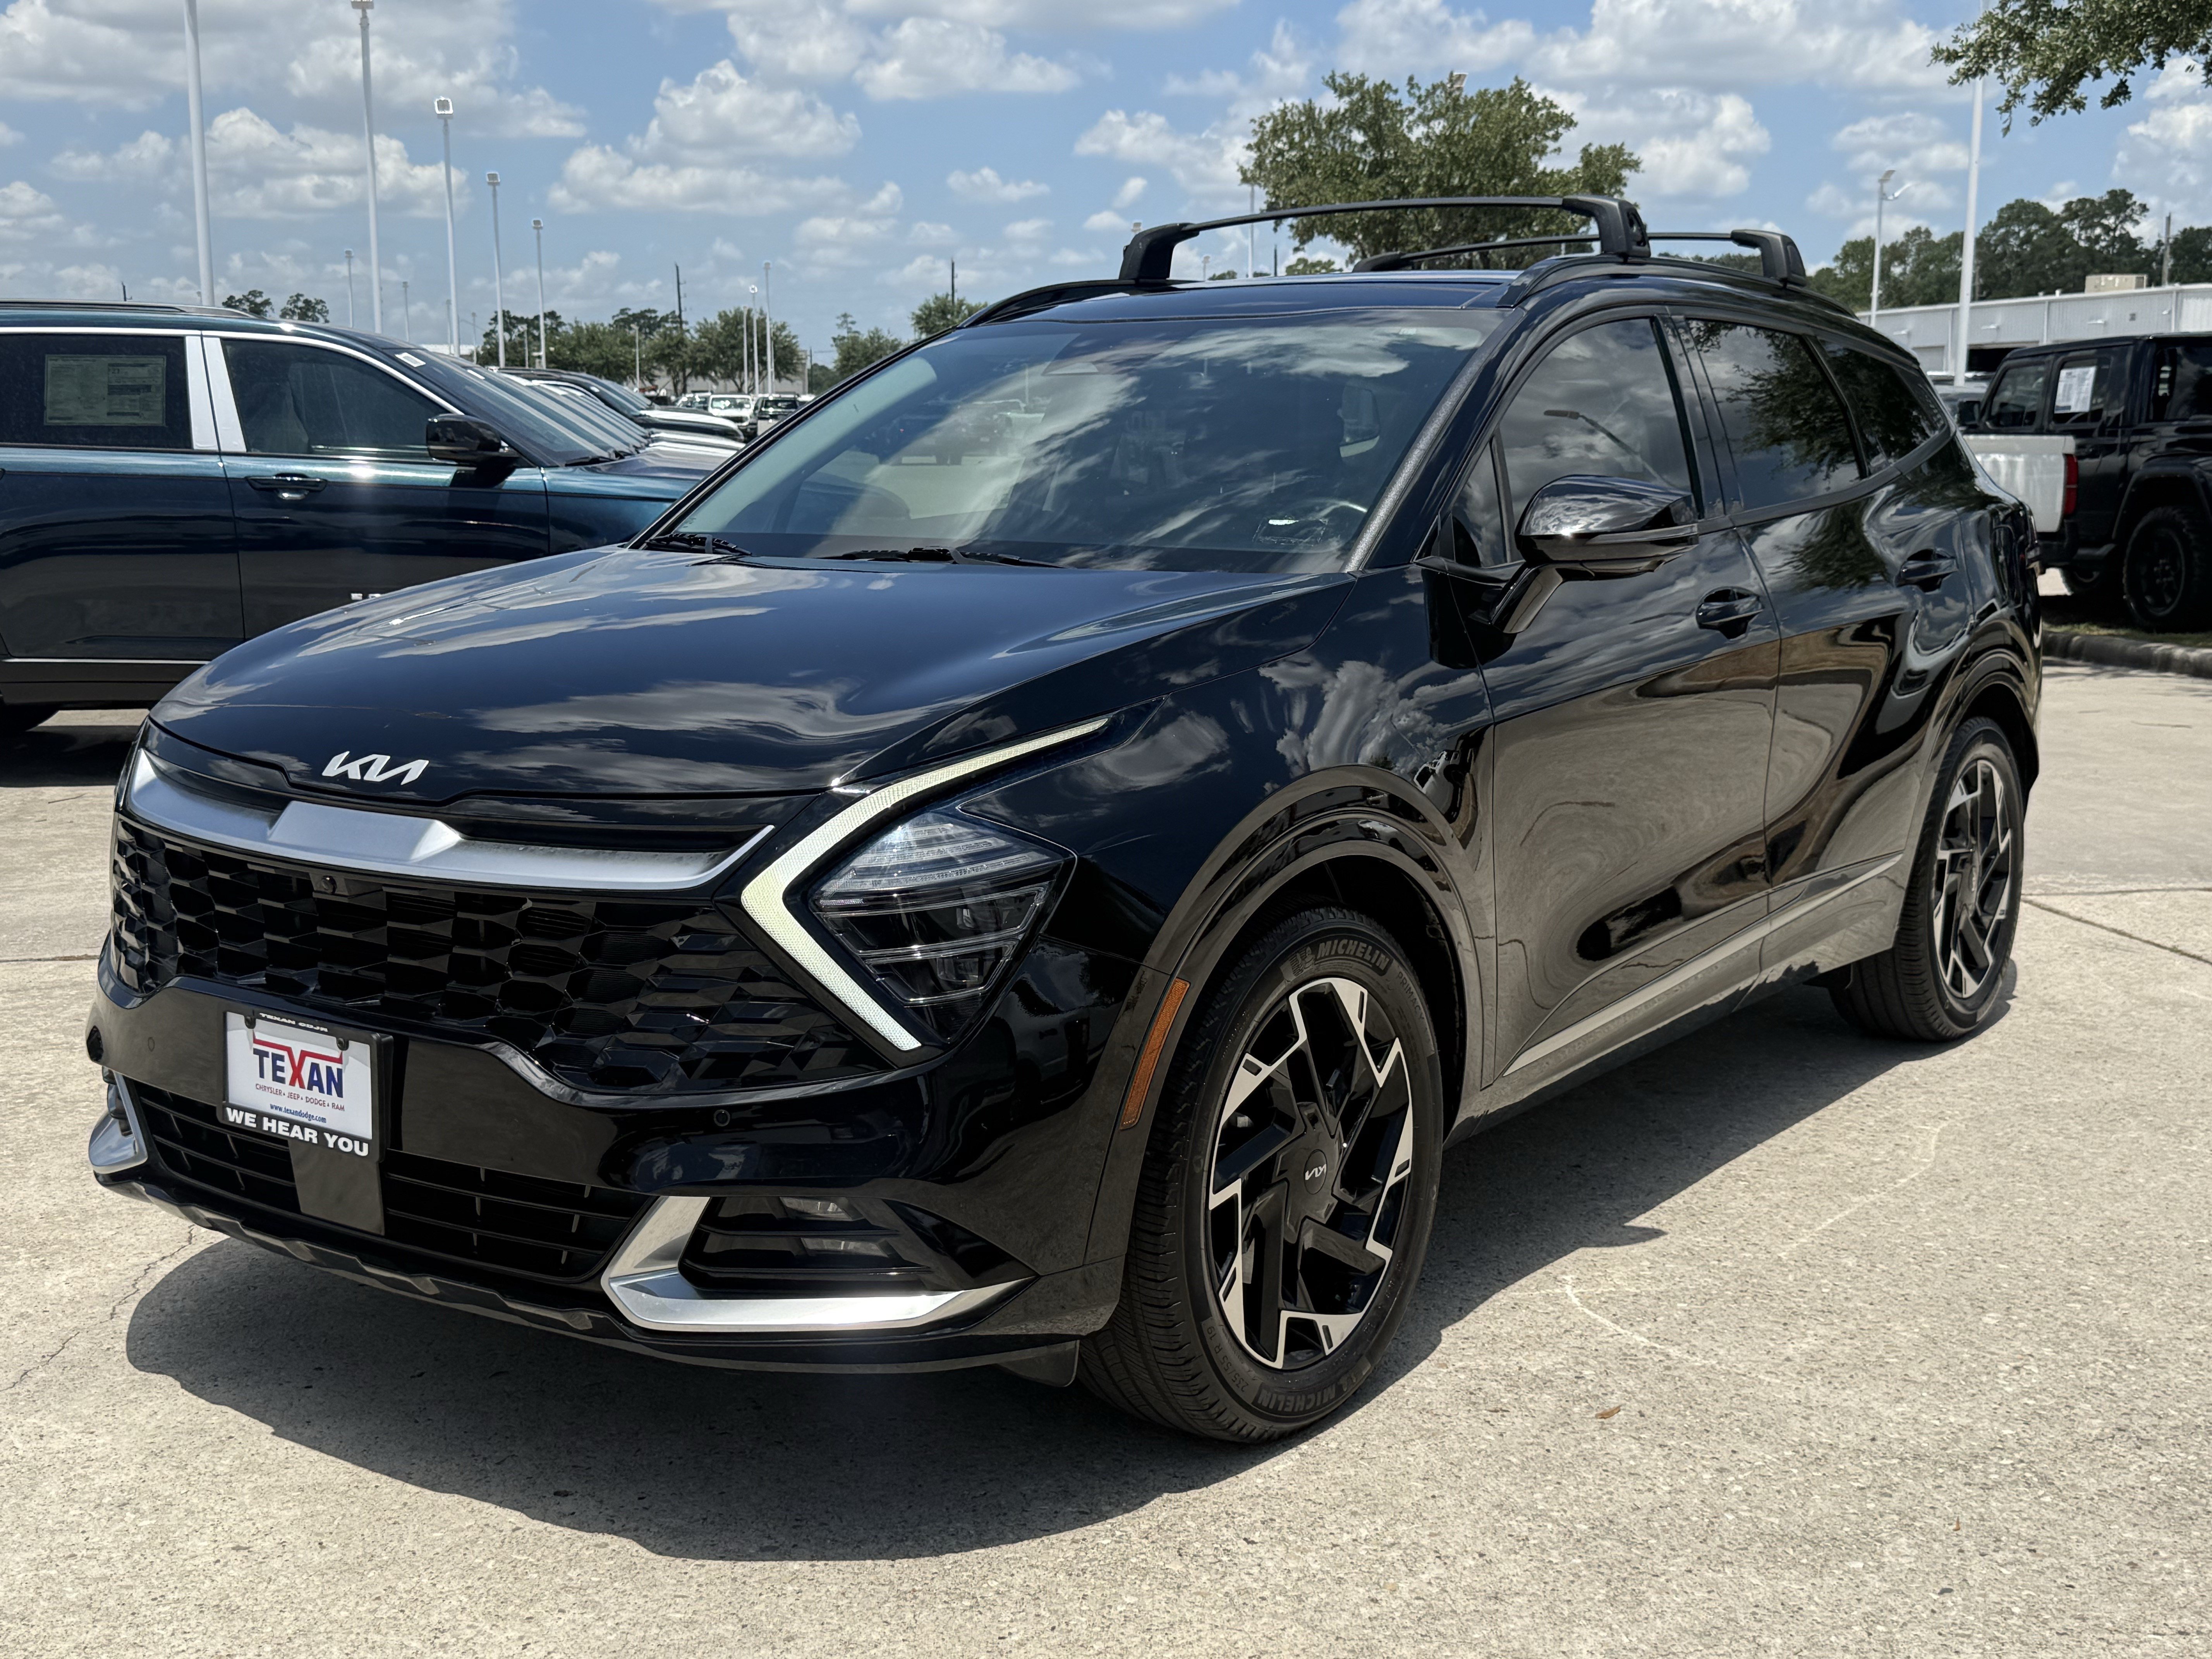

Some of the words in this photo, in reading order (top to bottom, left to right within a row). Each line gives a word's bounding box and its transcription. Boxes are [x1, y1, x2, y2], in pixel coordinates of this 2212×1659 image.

[1317, 939, 1390, 970] MICHELIN
[1396, 971, 1424, 1020] PRIMACY
[253, 1030, 343, 1098] TEXAN
[256, 1084, 282, 1096] CHRYSLER
[287, 1092, 300, 1100] JEEP
[305, 1096, 326, 1108] DODGE
[331, 1103, 345, 1111] RAM
[270, 1104, 326, 1123] www.texandodge.com
[226, 1107, 257, 1128] WE
[263, 1117, 318, 1144] HEAR
[324, 1132, 369, 1157] YOU
[1207, 1326, 1217, 1340] 19
[1214, 1343, 1223, 1354] R
[1220, 1355, 1249, 1393] 235/55
[1257, 1382, 1336, 1412] MICHELIN
